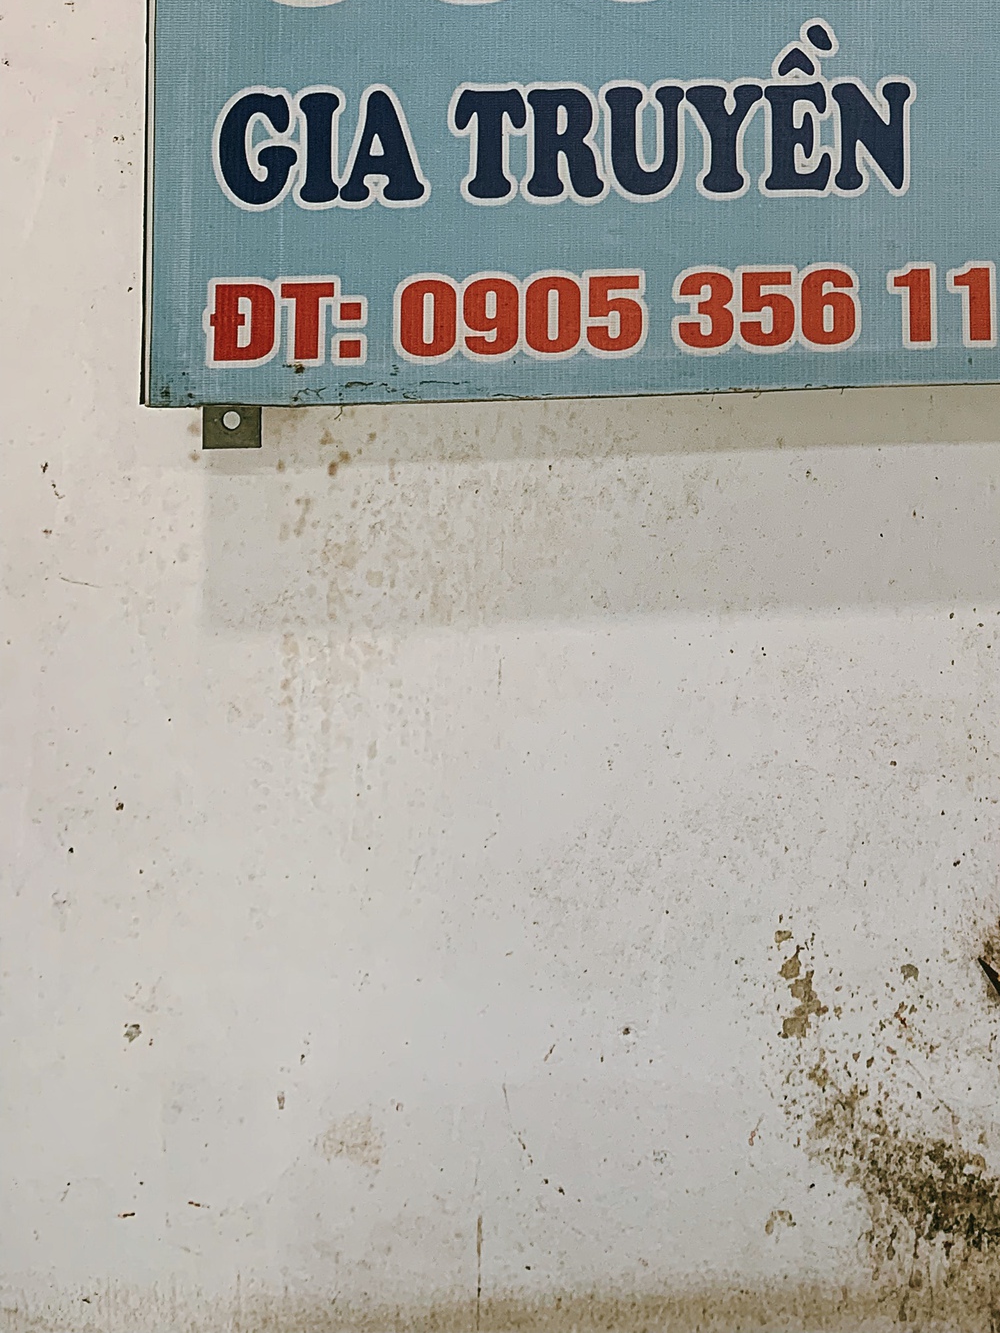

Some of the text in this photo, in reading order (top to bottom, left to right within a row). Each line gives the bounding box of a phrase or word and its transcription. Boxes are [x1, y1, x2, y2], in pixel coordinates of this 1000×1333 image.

[212, 19, 917, 212] GIA TRUYỀN
[203, 276, 370, 368] ĐT:
[390, 268, 649, 365] 0905
[670, 266, 863, 356] 356
